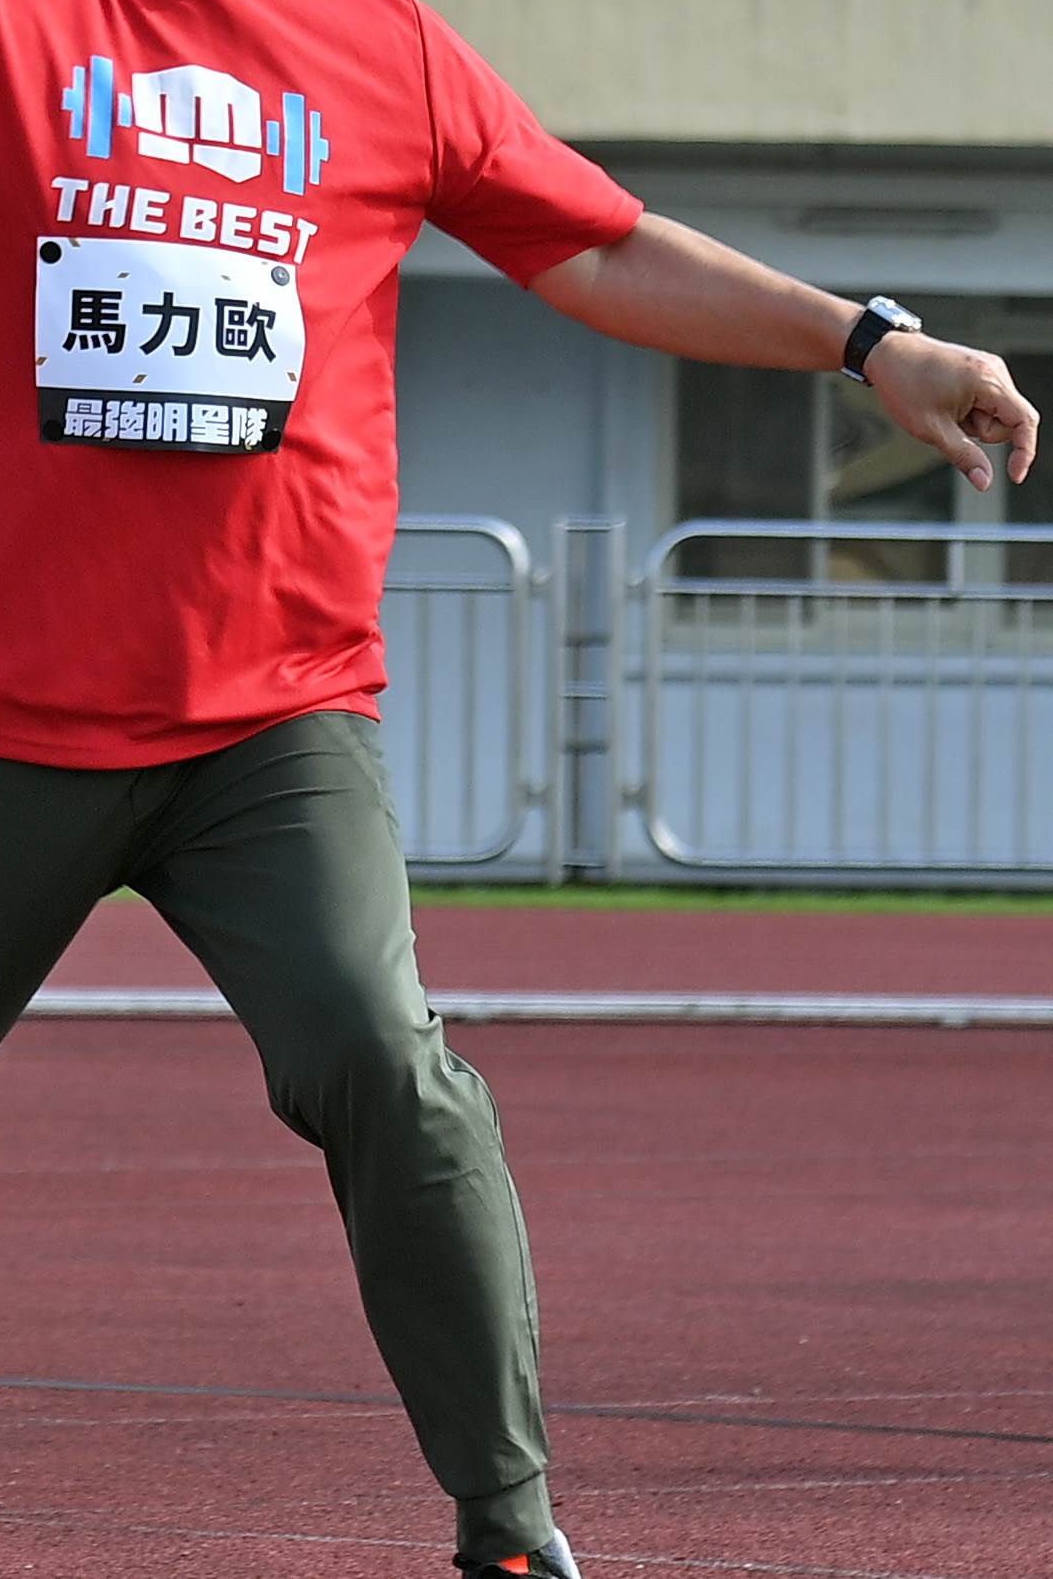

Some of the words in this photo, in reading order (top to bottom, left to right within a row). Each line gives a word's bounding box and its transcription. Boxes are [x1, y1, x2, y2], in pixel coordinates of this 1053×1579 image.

[51, 177, 170, 233] THE
[180, 196, 318, 263] BEST
[63, 289, 277, 362] 馬力歐
[64, 398, 268, 447] 最強明星隊
